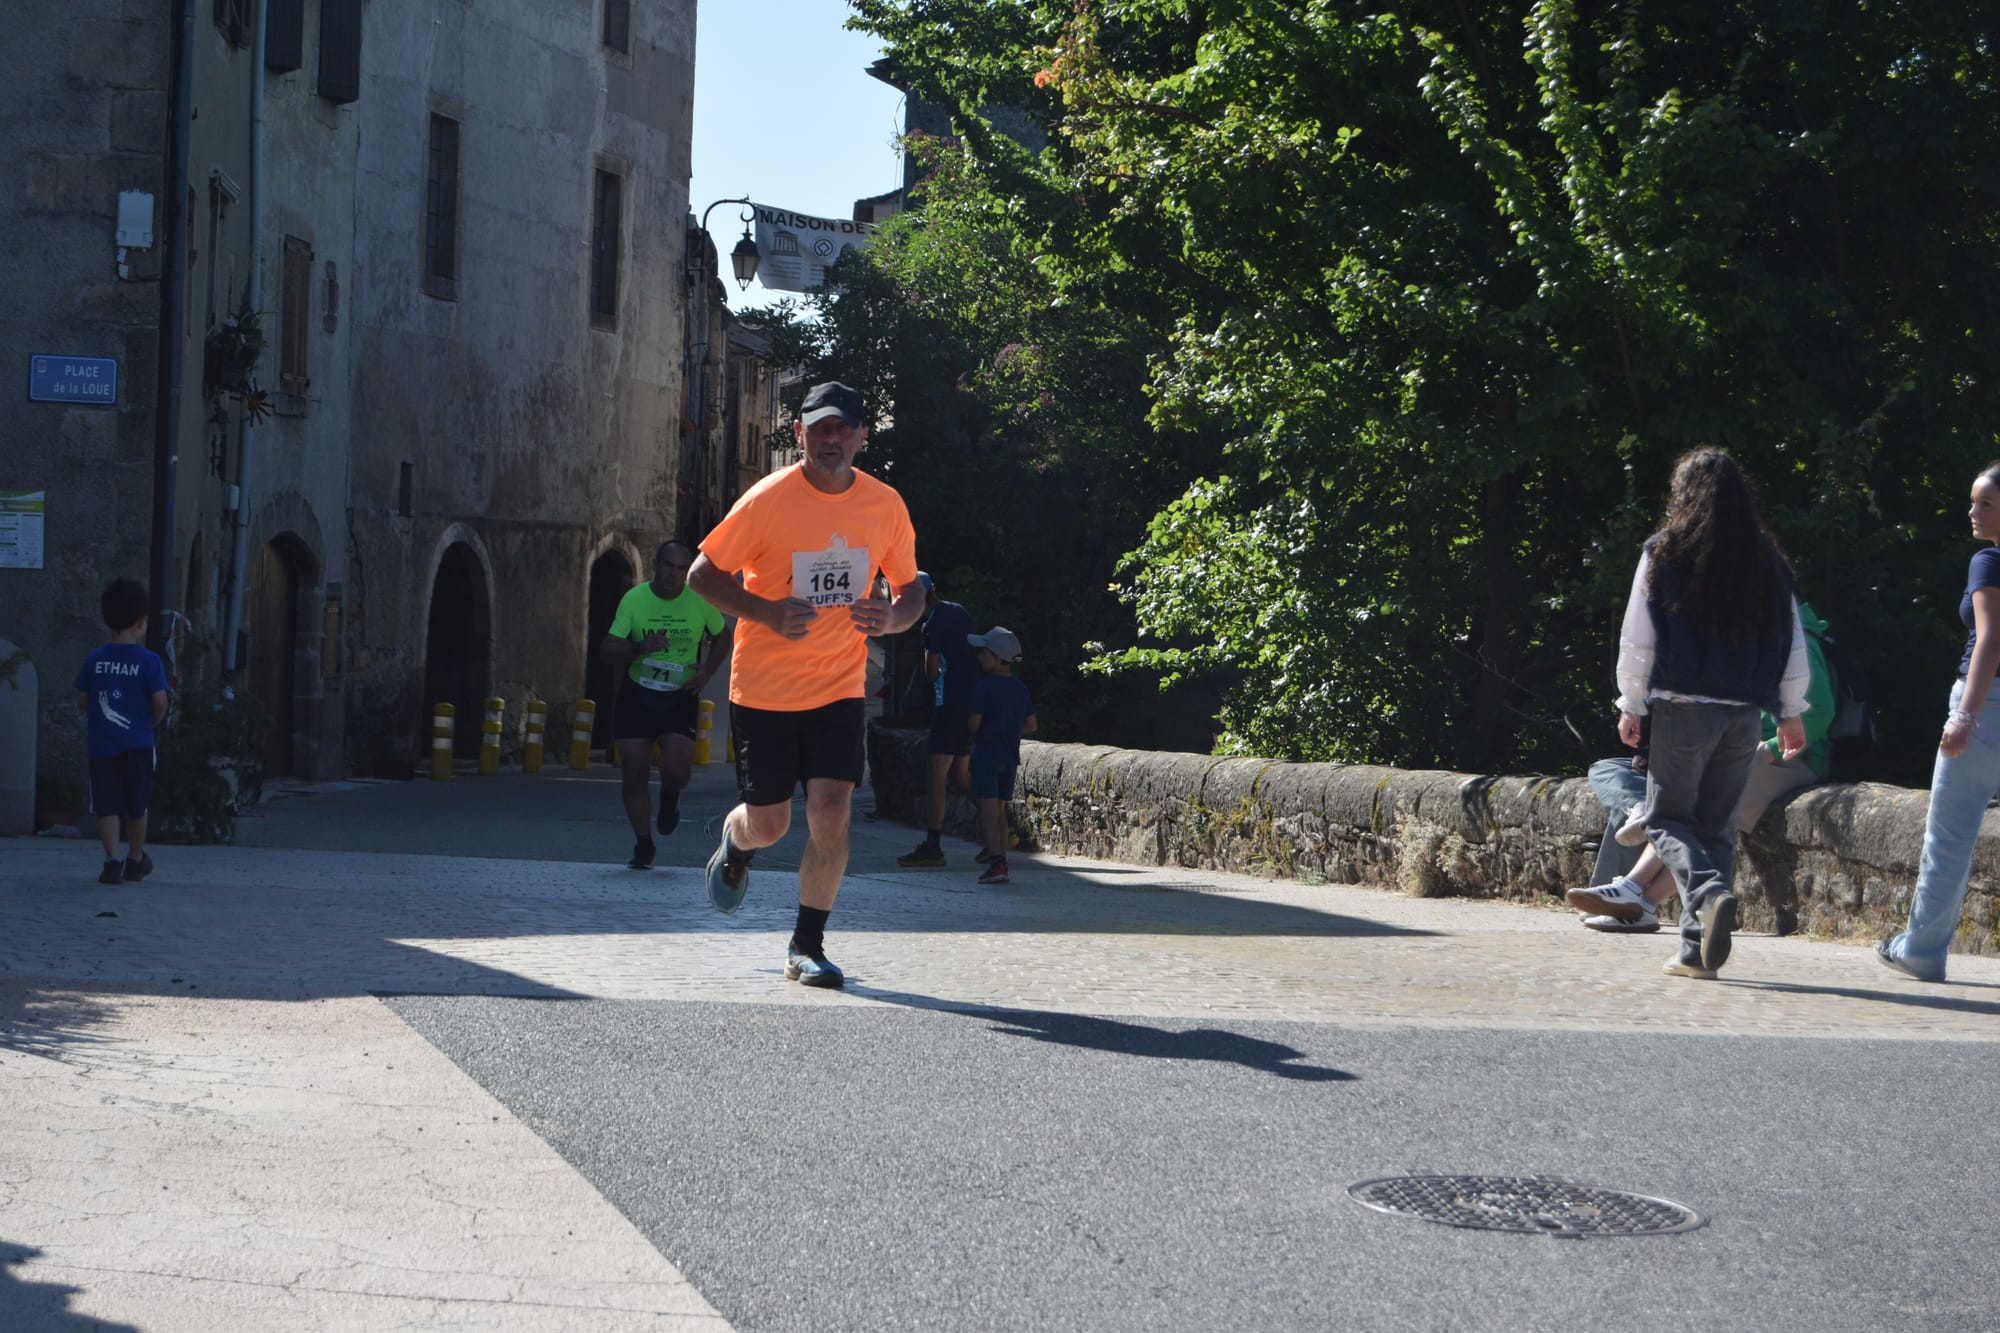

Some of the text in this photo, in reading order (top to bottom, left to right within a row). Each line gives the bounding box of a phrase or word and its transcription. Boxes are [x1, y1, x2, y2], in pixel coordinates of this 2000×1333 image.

[759, 209, 835, 233] MAISON
[841, 222, 866, 235] DE
[65, 364, 100, 378] PLACE
[53, 382, 110, 396] de la LOUE
[810, 571, 850, 592] 164
[806, 592, 853, 605] TUFF'S
[95, 661, 139, 676] ETHAN
[651, 666, 670, 682] 71
